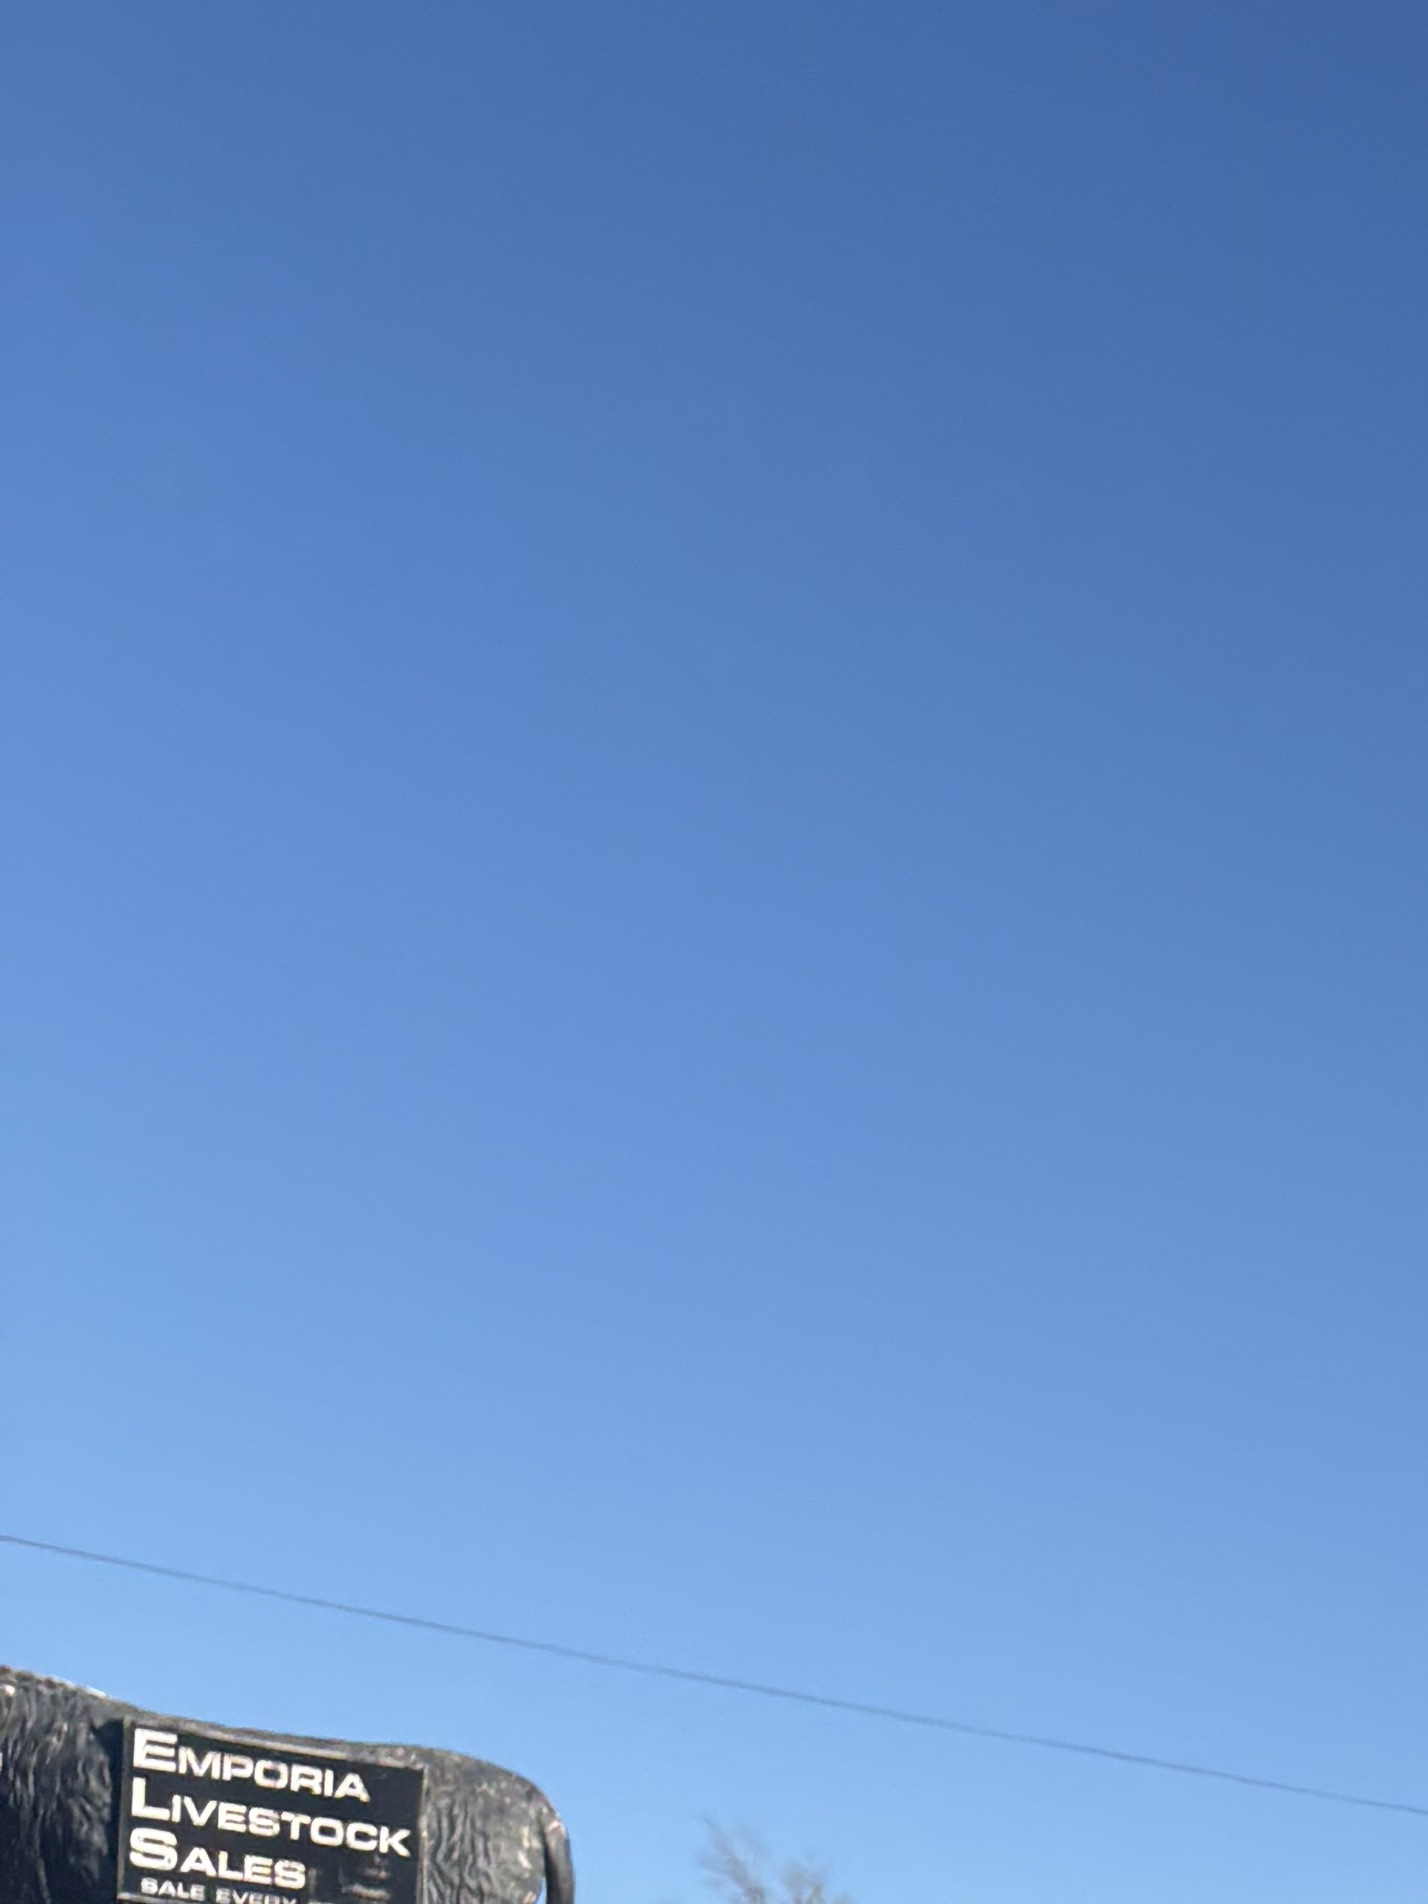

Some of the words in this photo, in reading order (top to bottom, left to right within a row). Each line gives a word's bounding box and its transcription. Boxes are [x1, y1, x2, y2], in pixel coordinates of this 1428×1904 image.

[133, 1727, 370, 1803] EMPORIA
[131, 1777, 412, 1857] LIVESTOCK
[129, 1827, 306, 1890] SALES
[140, 1877, 205, 1902] SALE
